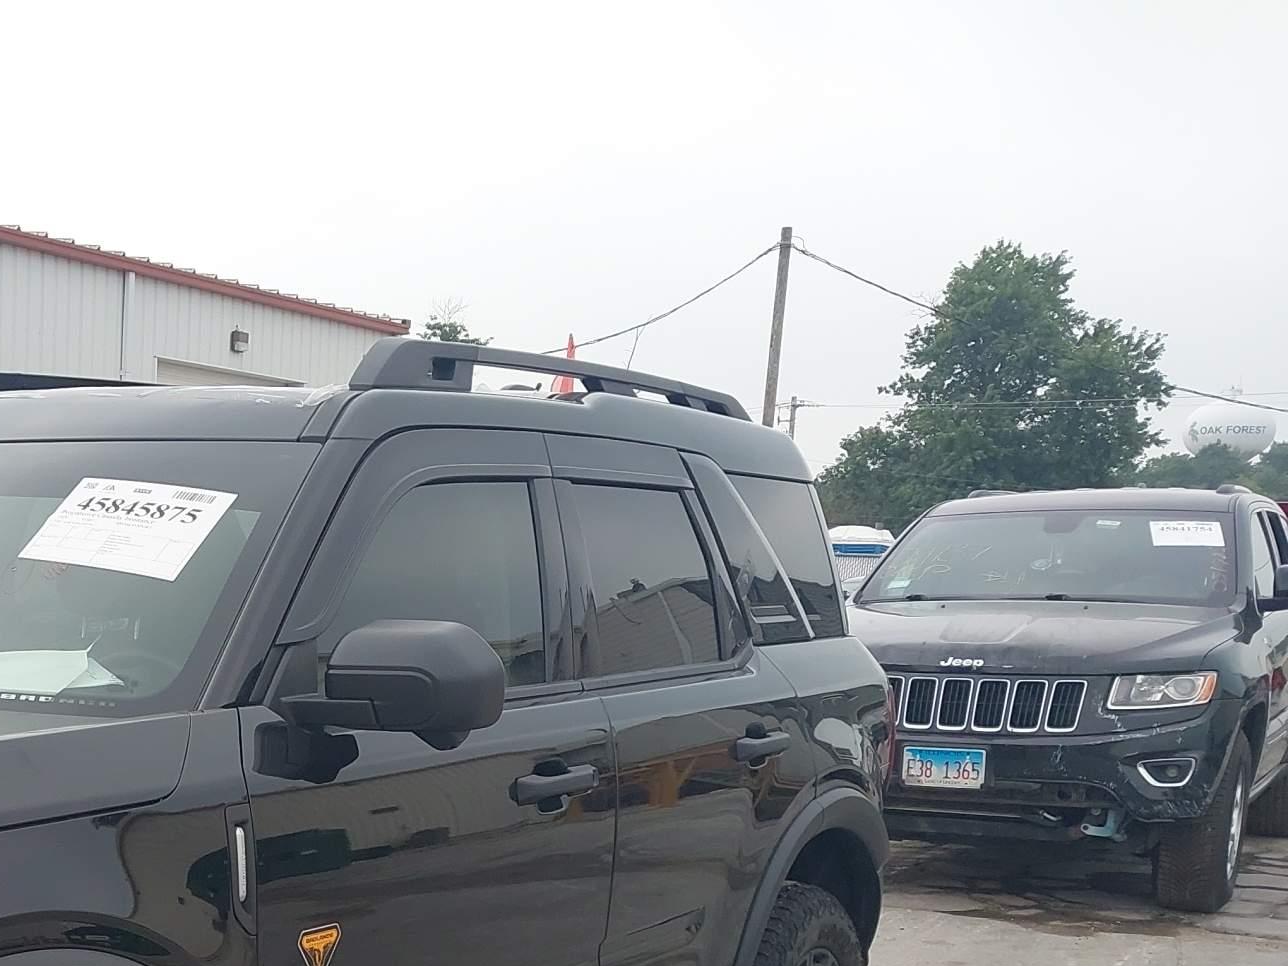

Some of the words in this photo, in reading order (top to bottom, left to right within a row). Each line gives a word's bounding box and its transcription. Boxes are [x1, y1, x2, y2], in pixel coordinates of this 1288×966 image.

[1199, 426, 1223, 435] OAK
[1226, 425, 1267, 434] FOREST
[77, 496, 204, 524] 45845875
[939, 656, 985, 670] Jeep
[906, 758, 933, 778] E38
[942, 760, 980, 780] 1365
